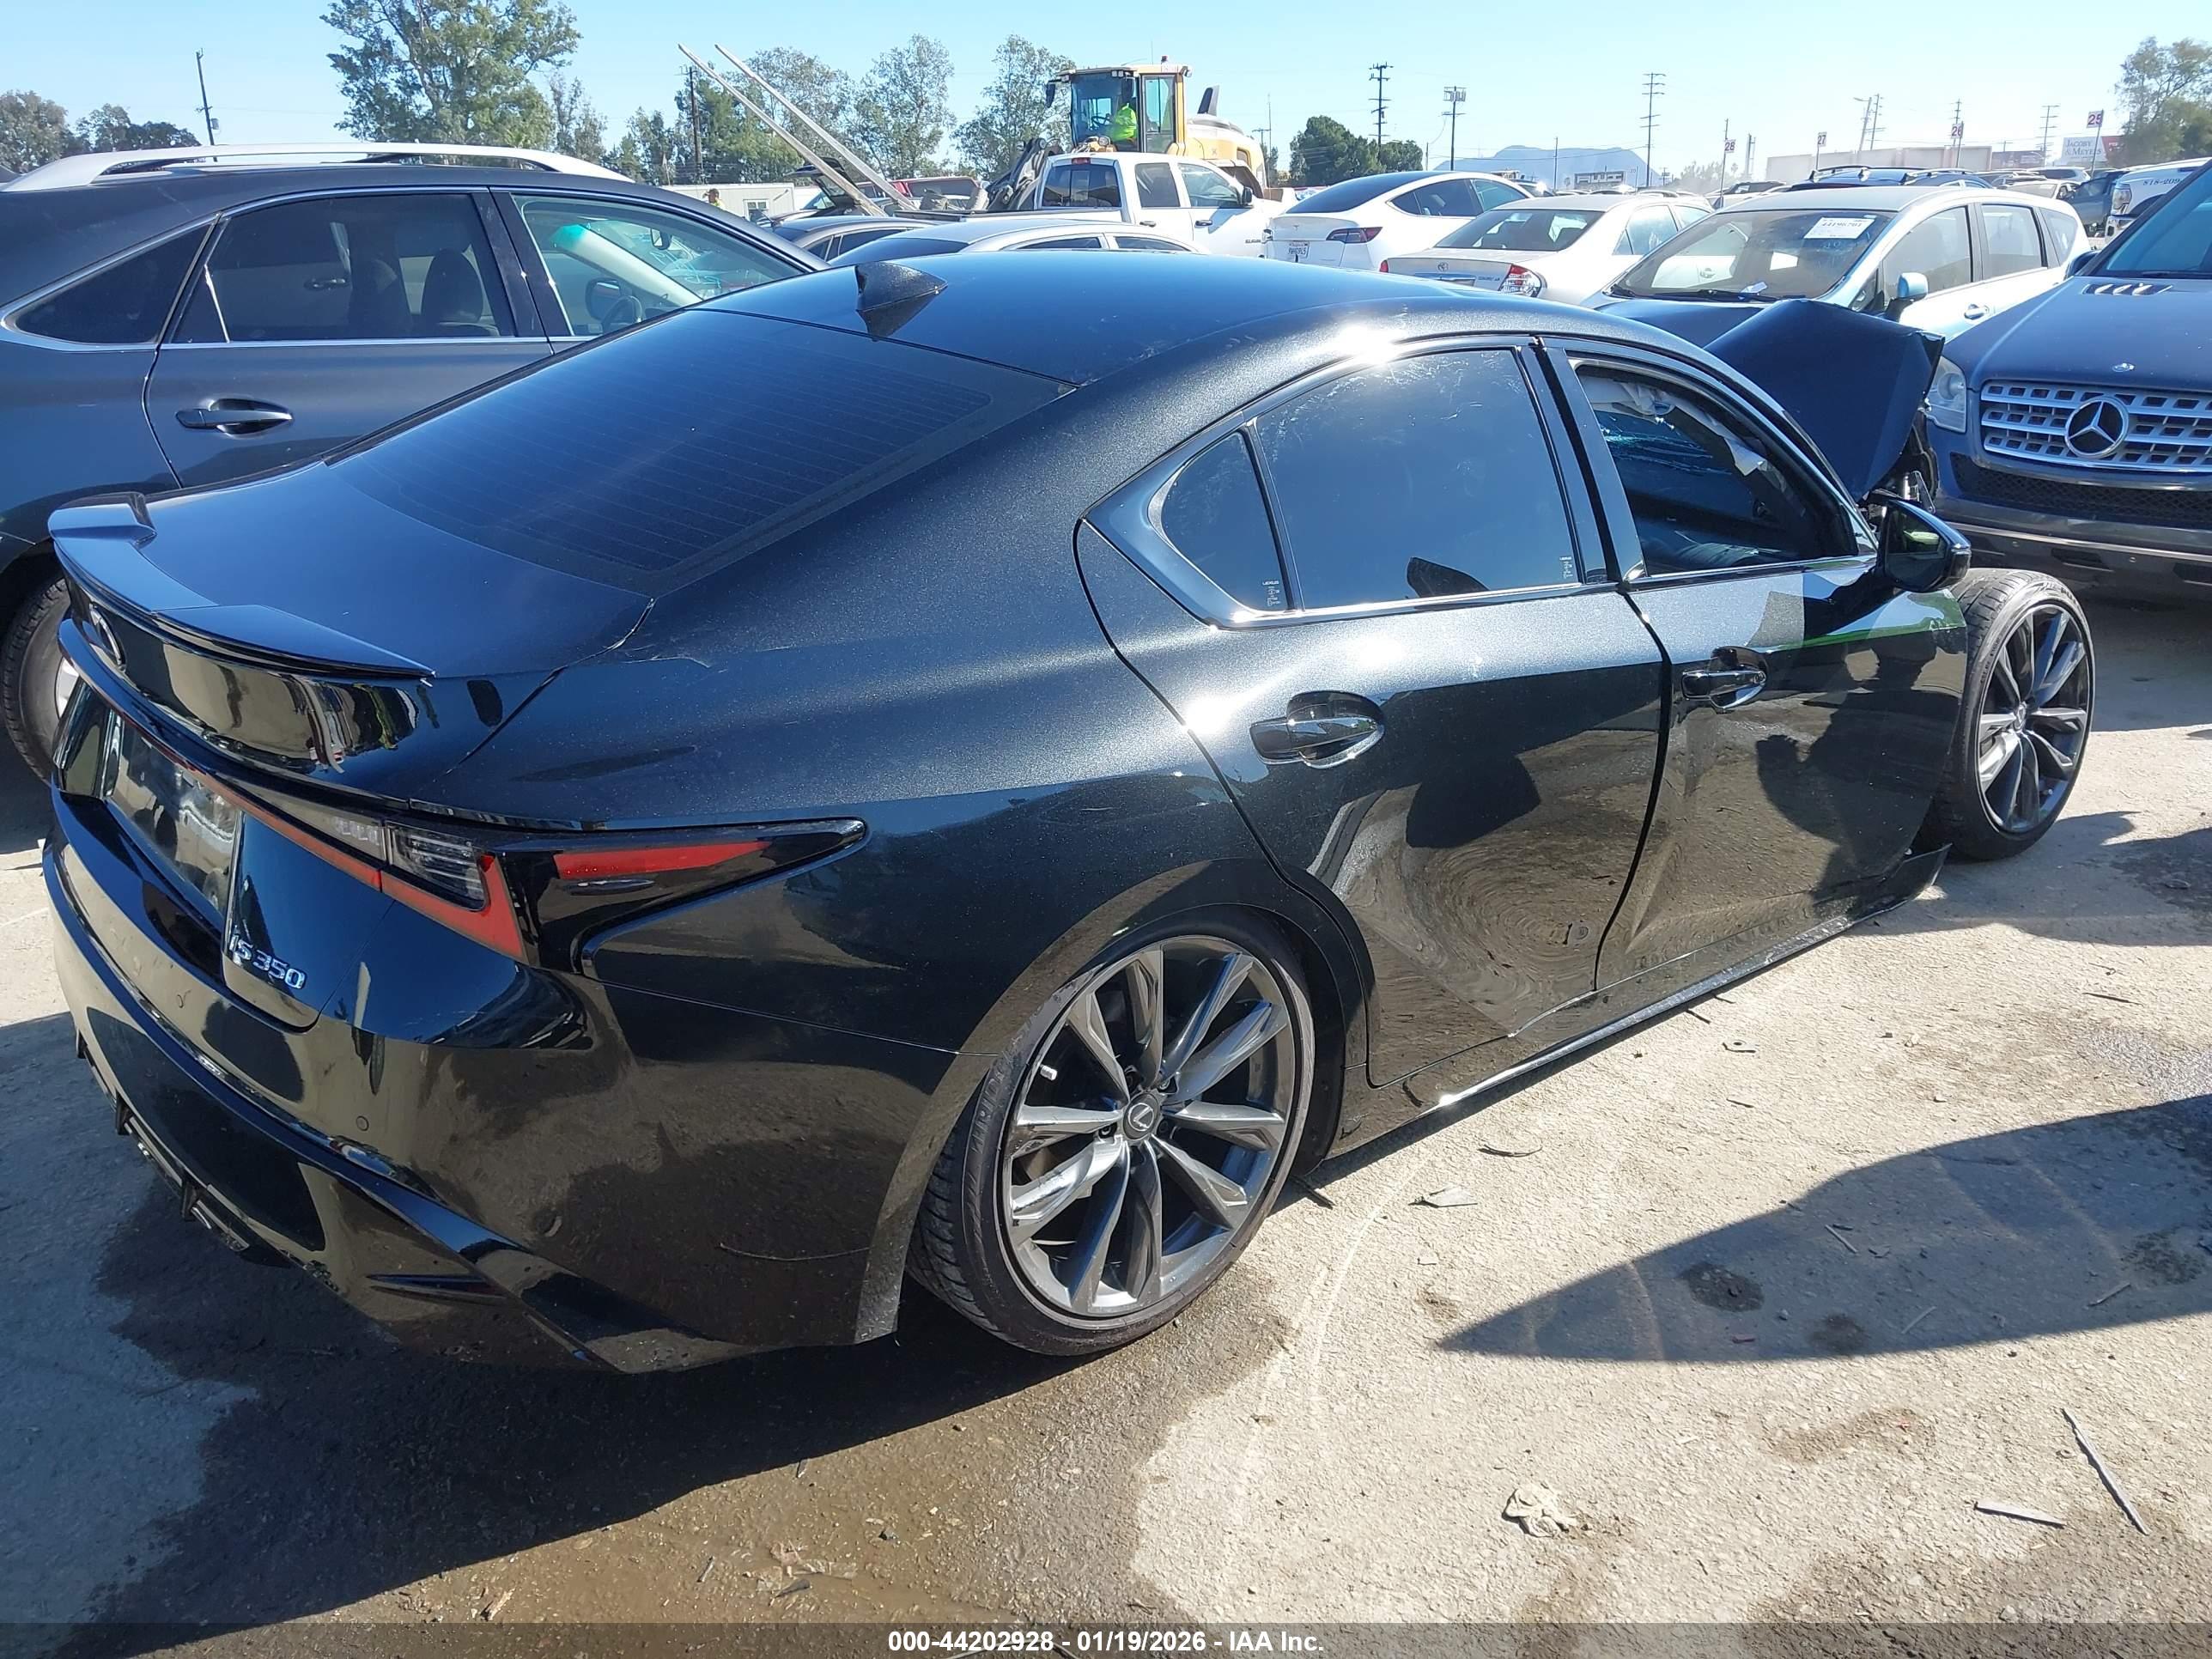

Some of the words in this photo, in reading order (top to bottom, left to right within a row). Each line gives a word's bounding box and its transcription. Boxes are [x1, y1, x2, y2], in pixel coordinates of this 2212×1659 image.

[2087, 114, 2102, 125] 25
[1818, 135, 1826, 145] 27
[1724, 142, 1735, 152] 28
[2073, 147, 2101, 155] MEYES
[252, 949, 307, 989] 350
